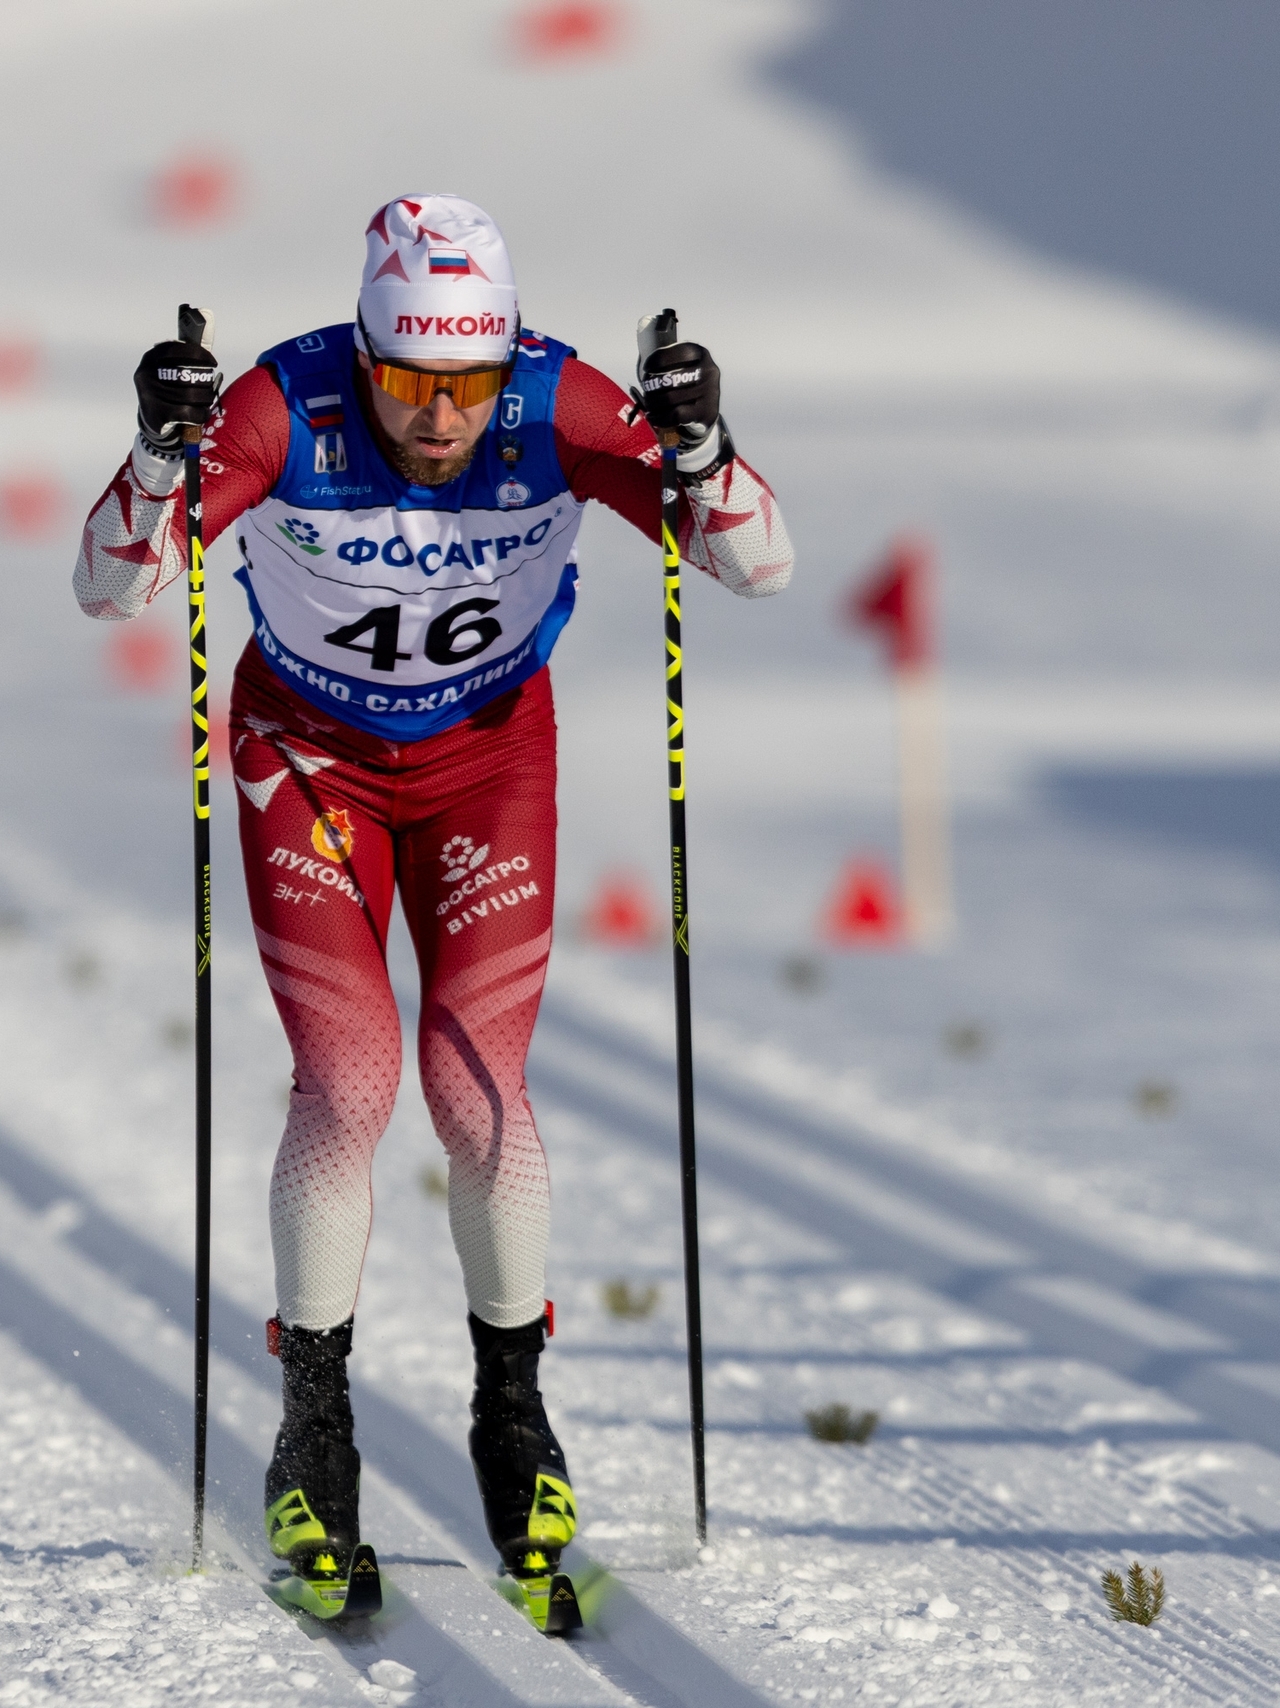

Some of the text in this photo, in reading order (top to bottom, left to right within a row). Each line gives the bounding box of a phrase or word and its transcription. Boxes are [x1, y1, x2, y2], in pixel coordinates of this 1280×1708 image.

[394, 312, 506, 336] ЛУКОЙЛ
[336, 518, 553, 577] ФОСАГРО
[323, 597, 503, 672] 46
[266, 847, 365, 908] ЛУКОЙЛ
[436, 855, 530, 916] ФОСАГРО
[446, 880, 539, 935] BIVIUM
